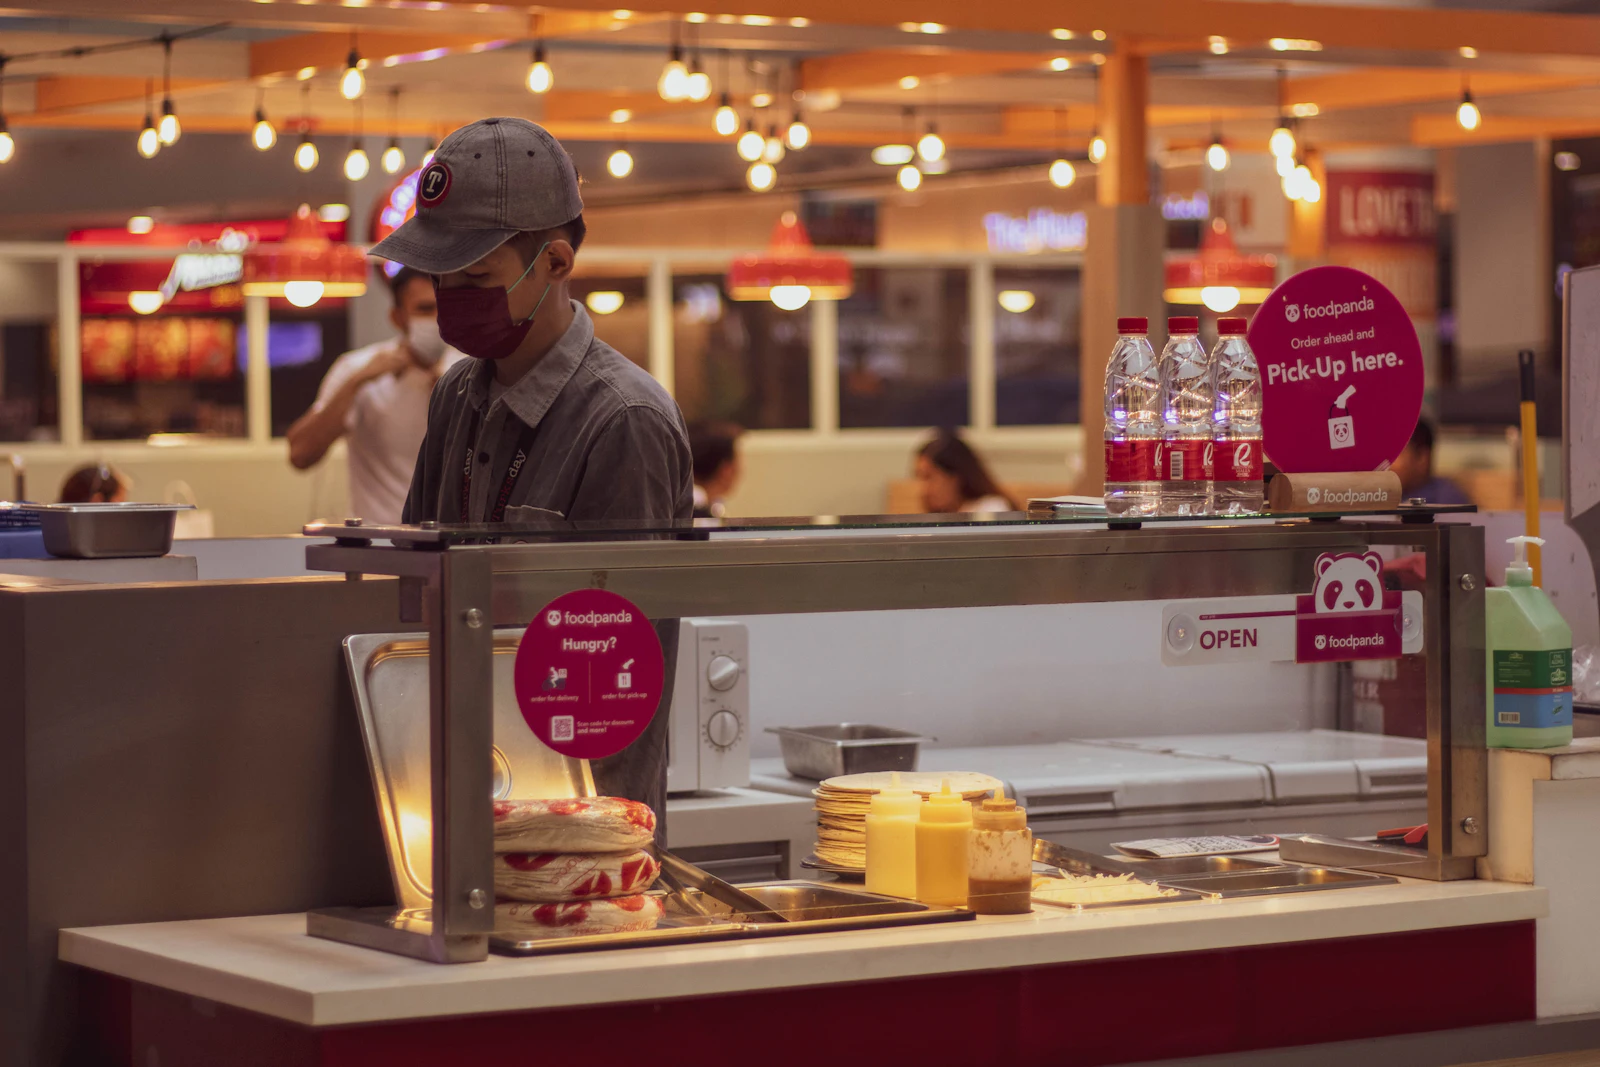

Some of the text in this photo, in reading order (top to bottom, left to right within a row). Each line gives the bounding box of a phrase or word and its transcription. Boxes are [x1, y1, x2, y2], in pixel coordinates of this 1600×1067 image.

[426, 171, 442, 192] T
[1303, 296, 1375, 319] foodpanda
[1291, 326, 1375, 349] Order ahead and
[1267, 350, 1404, 385] Pick-Up here.
[1323, 488, 1388, 505] foodpanda
[565, 610, 632, 627] foodpanda
[563, 637, 617, 652] Hungry?
[1200, 628, 1258, 650] OPEN
[1329, 633, 1385, 649] foodpanda
[556, 694, 579, 702] delivery
